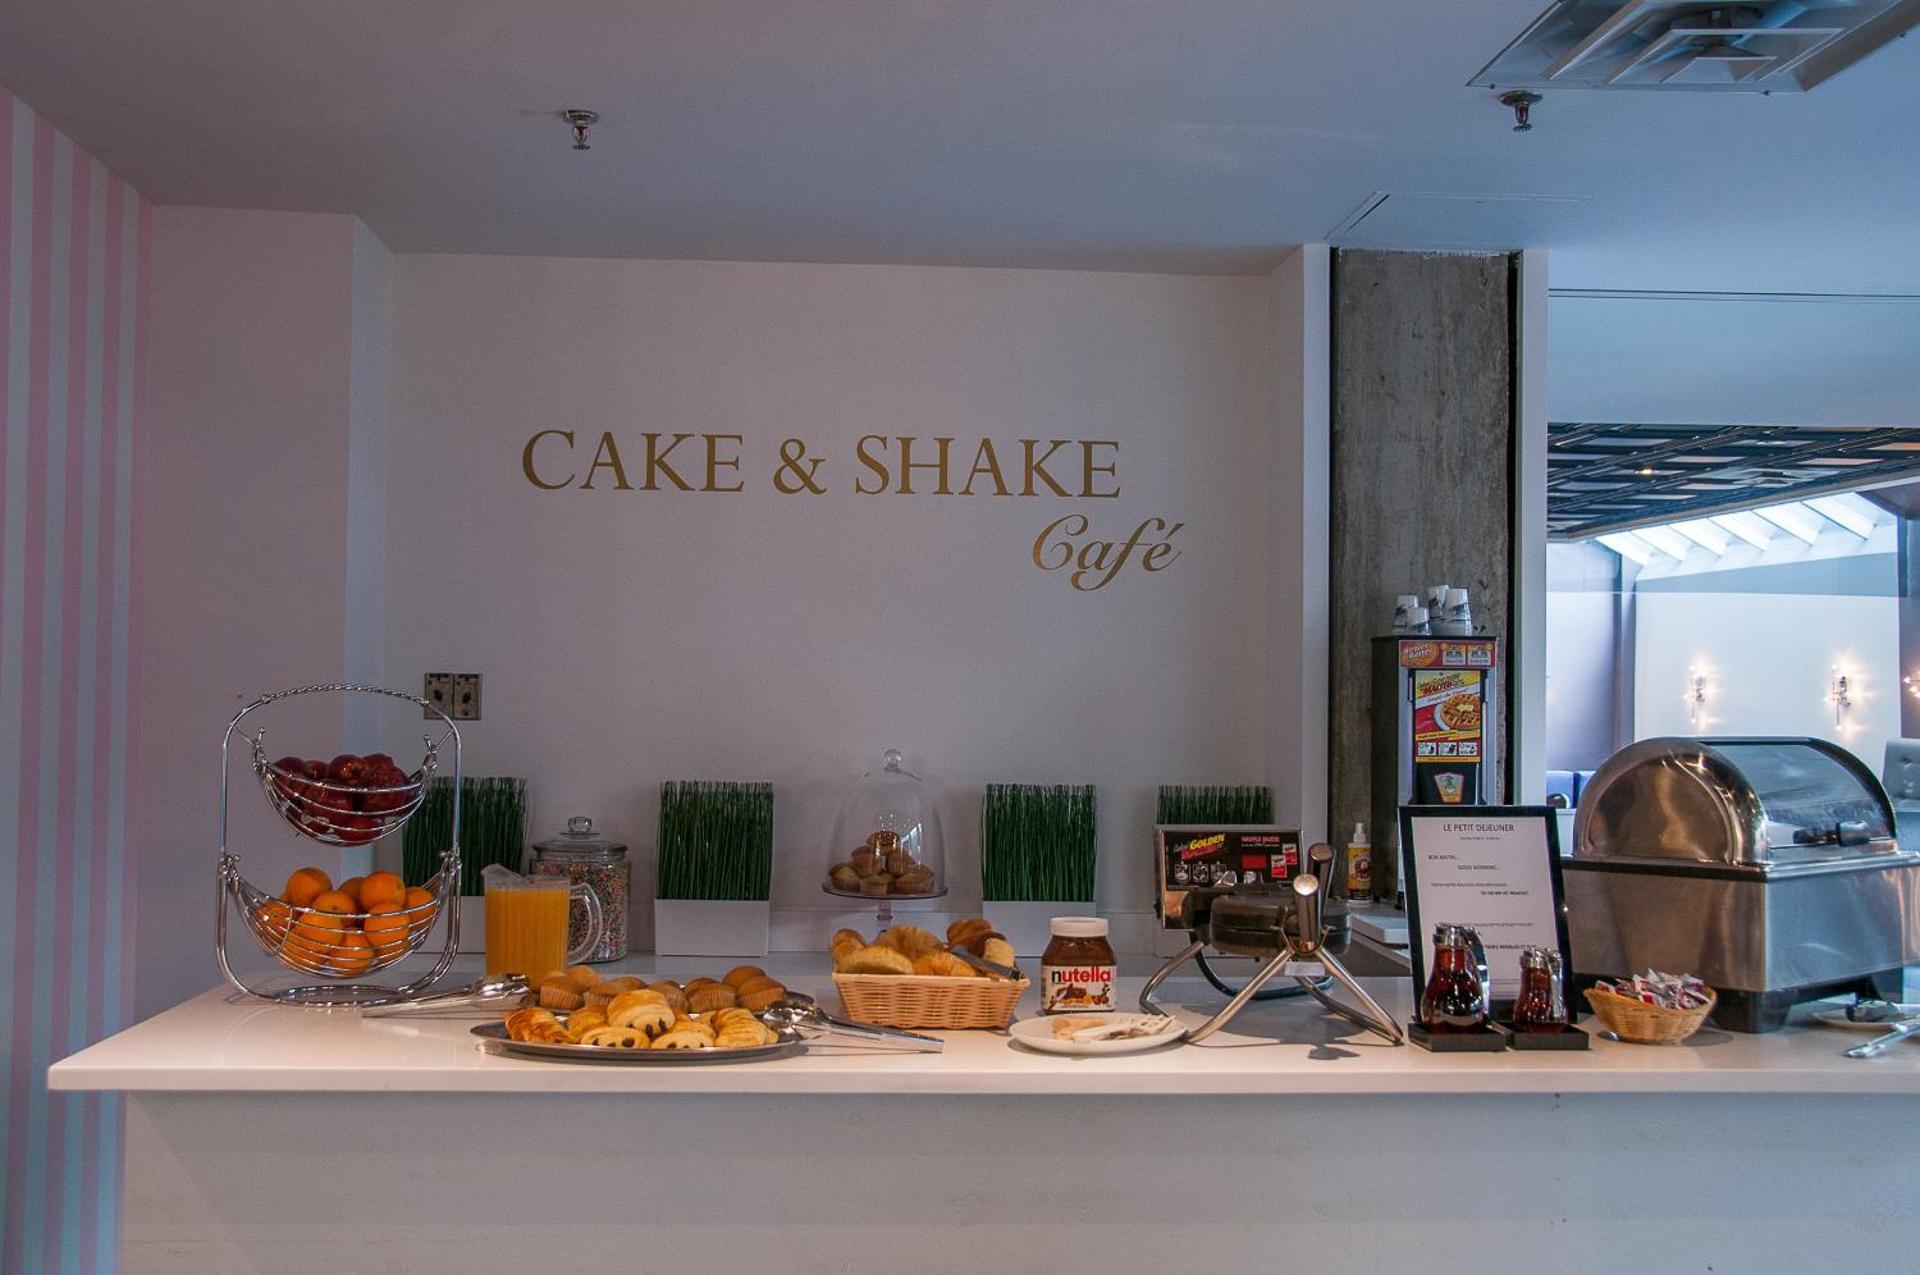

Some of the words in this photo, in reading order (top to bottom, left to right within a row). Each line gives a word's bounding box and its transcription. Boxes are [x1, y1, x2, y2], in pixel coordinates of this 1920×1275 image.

[521, 430, 745, 493] CAKE
[772, 438, 828, 495] &
[854, 434, 1122, 498] SHAKE
[1031, 514, 1186, 591] Café
[1443, 823, 1452, 832] LE
[1453, 823, 1474, 832] PETIT
[1190, 833, 1226, 850] GOLDEN
[1052, 965, 1111, 983] nutella
